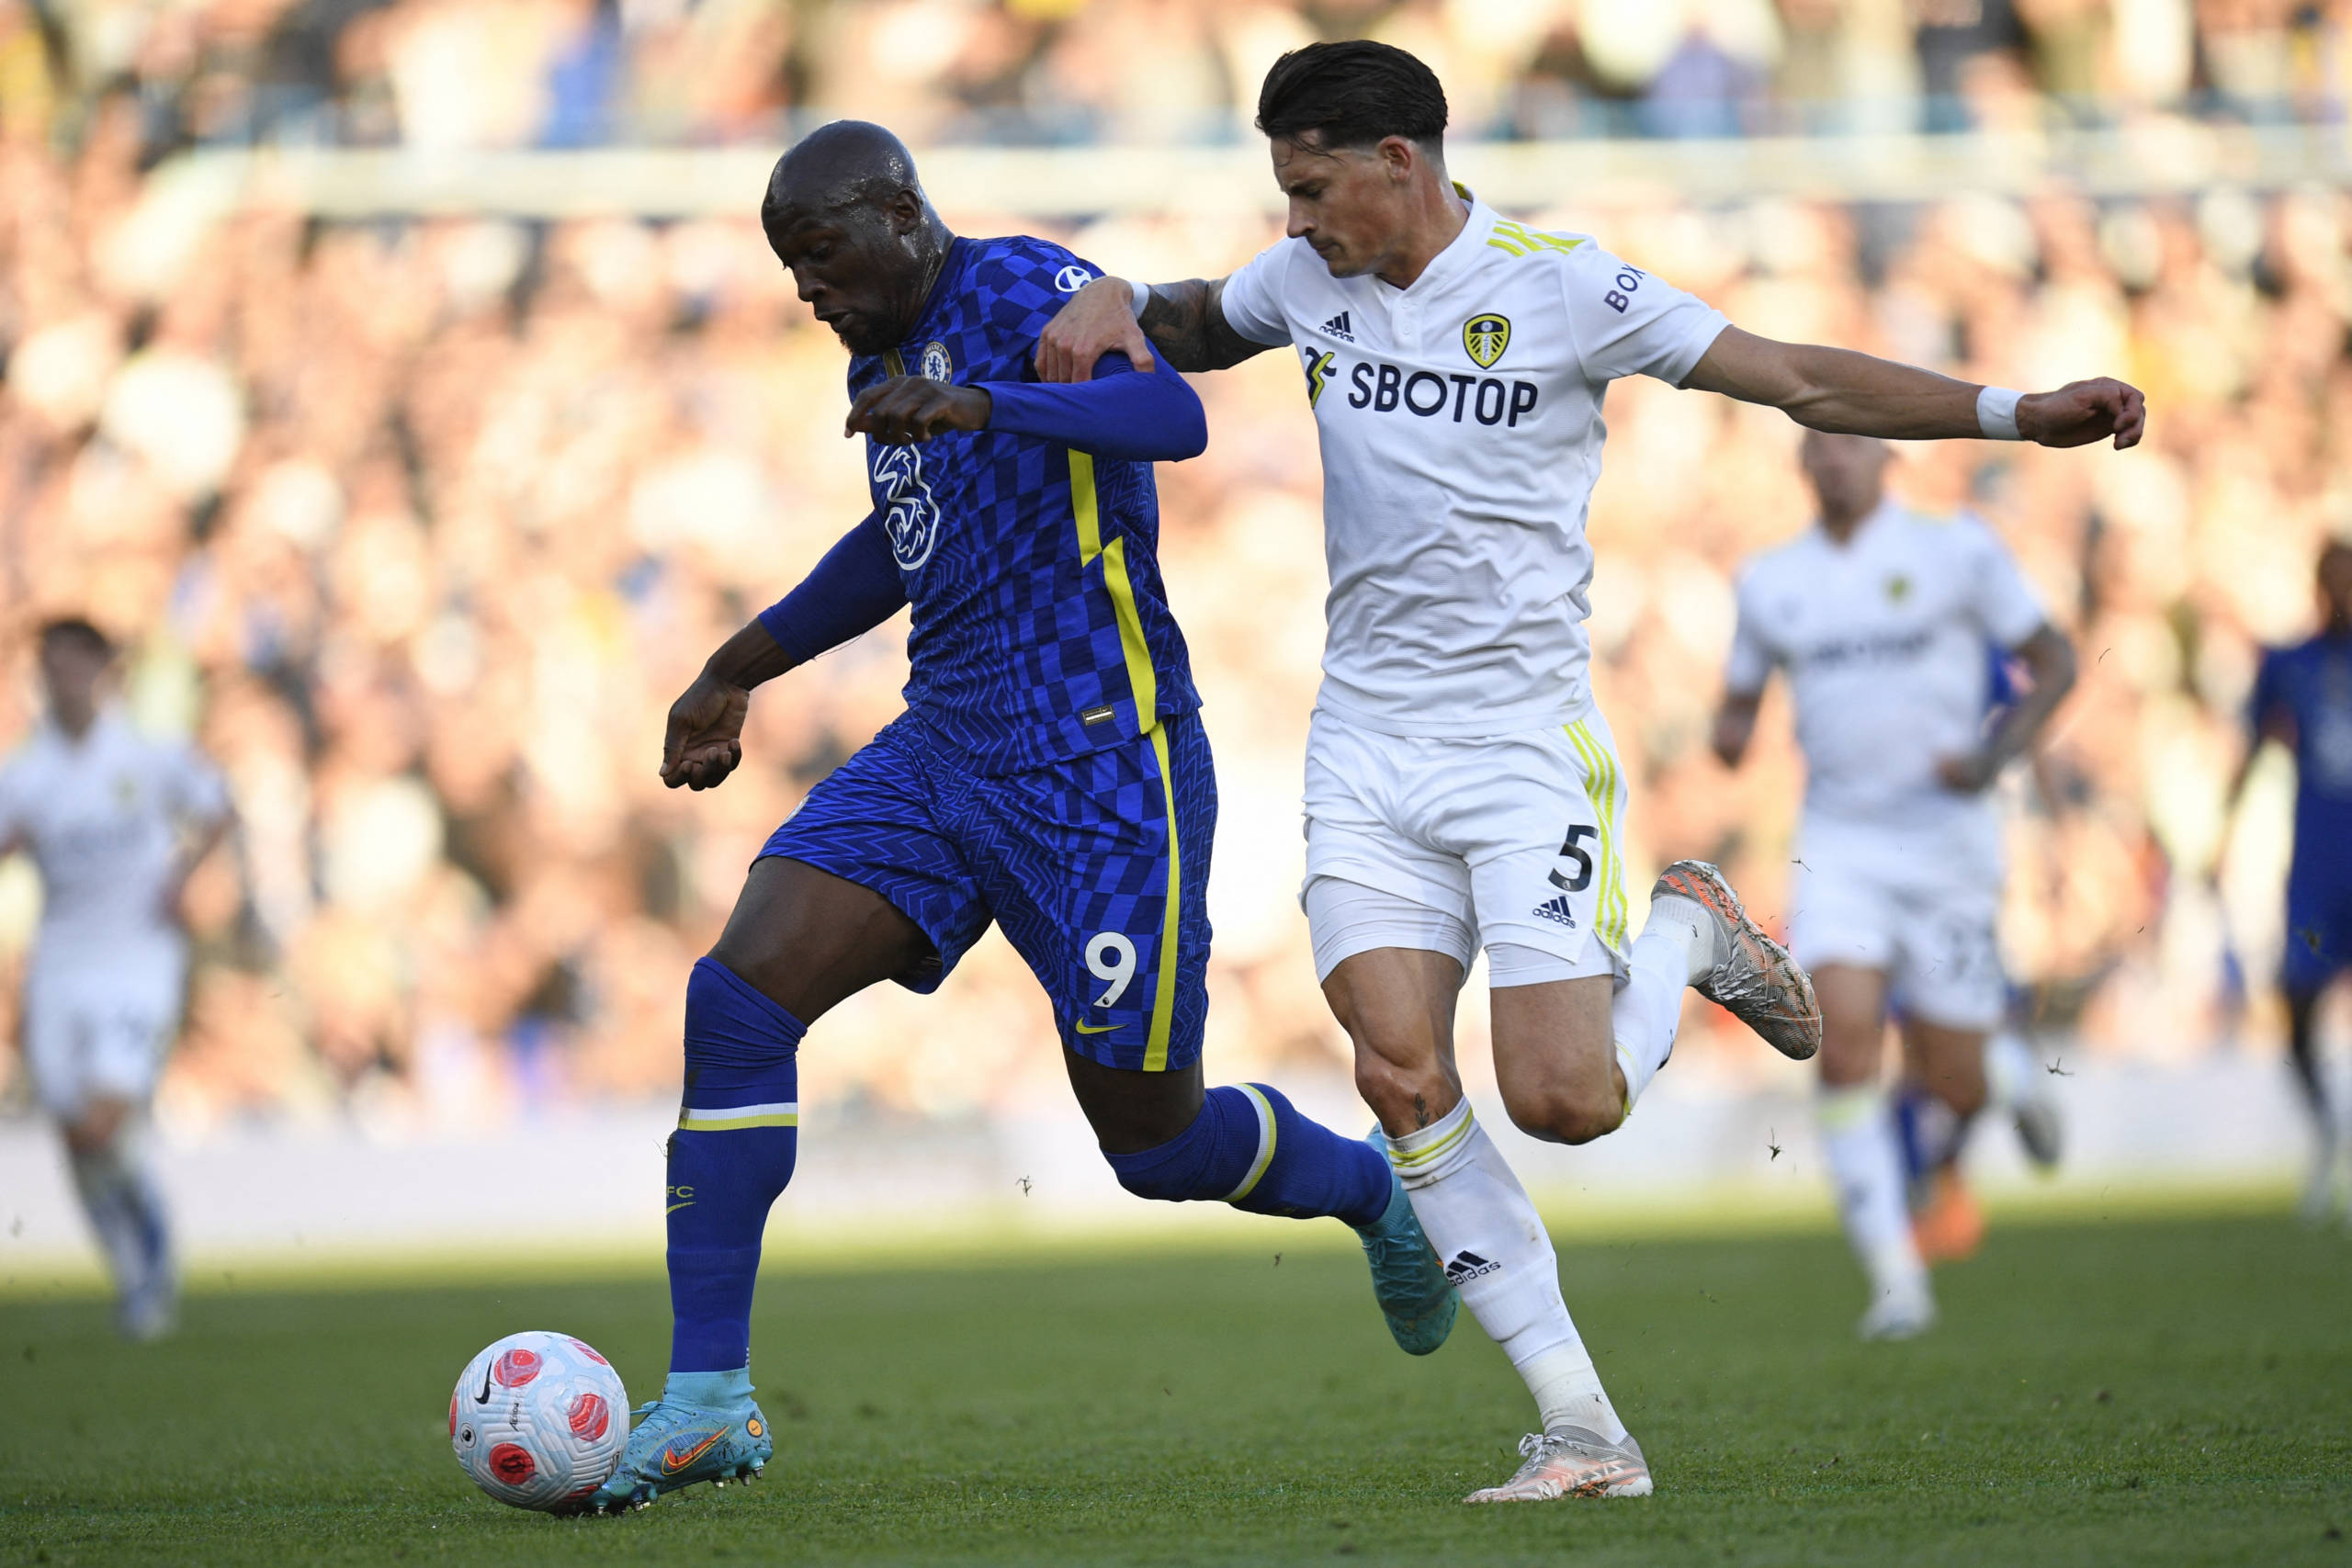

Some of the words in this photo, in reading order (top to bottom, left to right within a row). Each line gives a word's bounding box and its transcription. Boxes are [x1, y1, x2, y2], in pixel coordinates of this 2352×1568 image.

[1603, 264, 1645, 313] BOX
[1348, 362, 1538, 427] SBOTOP
[1548, 824, 1599, 892] 5
[1532, 908, 1576, 929] adidas
[1085, 931, 1136, 1008] 9
[1449, 1261, 1501, 1286] adidas
